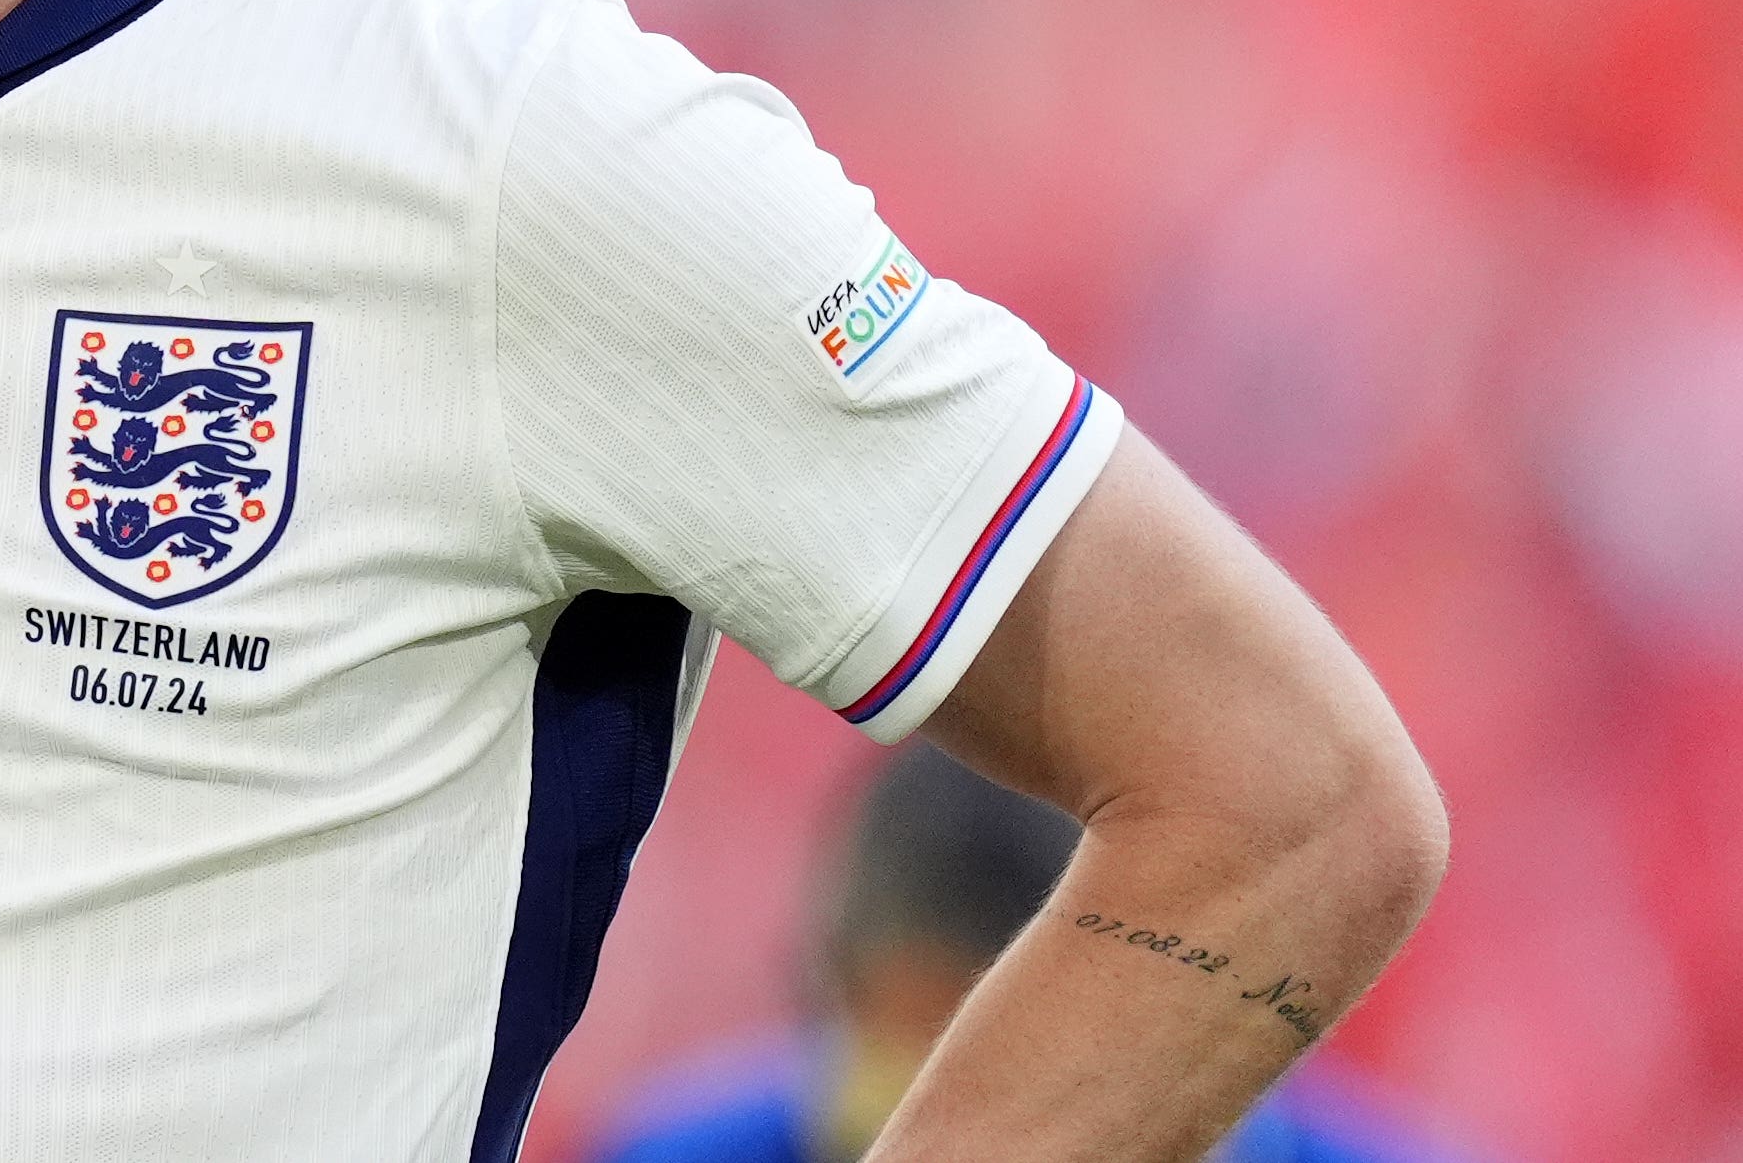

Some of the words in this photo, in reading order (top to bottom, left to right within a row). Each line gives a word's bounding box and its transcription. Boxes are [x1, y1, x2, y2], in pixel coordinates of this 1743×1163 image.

[807, 279, 859, 335] UEFA
[25, 607, 270, 672] SWITZERLAND
[70, 664, 207, 716] 06.07.24
